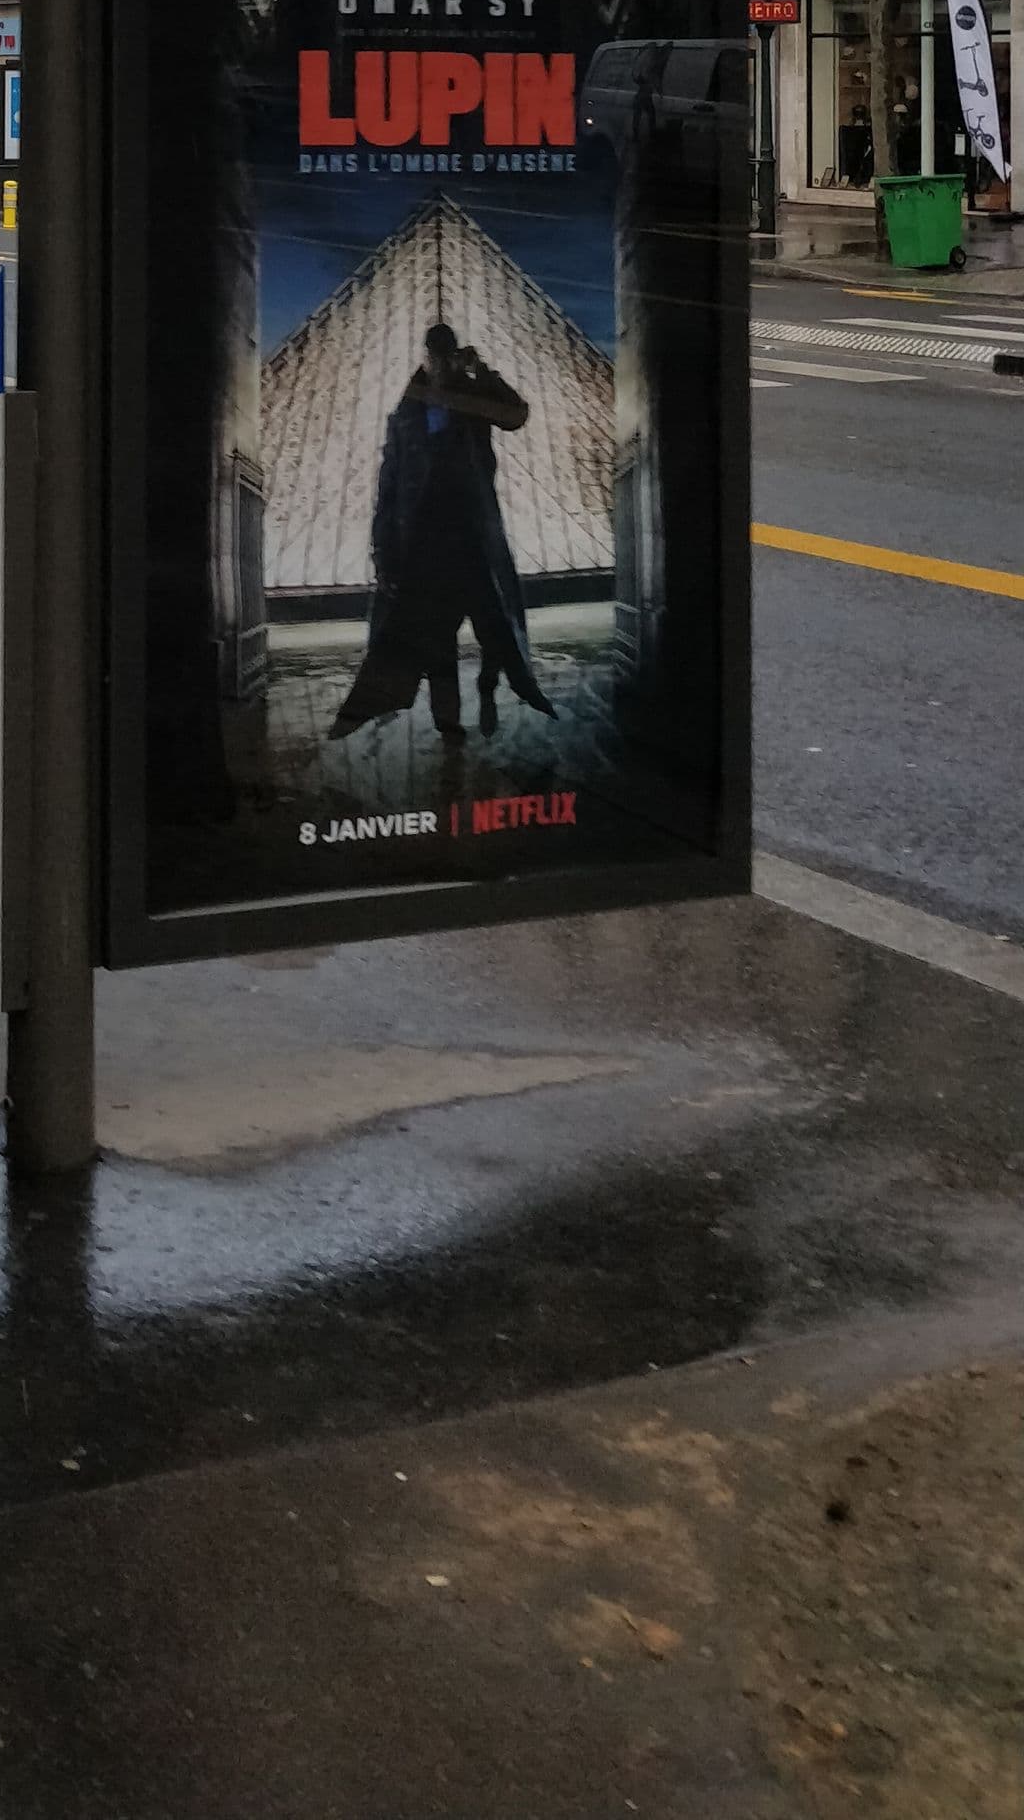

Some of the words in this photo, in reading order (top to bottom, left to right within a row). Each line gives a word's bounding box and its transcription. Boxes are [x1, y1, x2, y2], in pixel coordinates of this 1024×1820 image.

[298, 49, 577, 148] LUPIN
[298, 153, 359, 174] DANS
[367, 152, 463, 174] L'OMBRE
[471, 149, 577, 174] D'ARSÈNE
[298, 820, 318, 846] 8
[321, 810, 439, 844] JANVIER
[471, 791, 577, 835] NETFLIX
